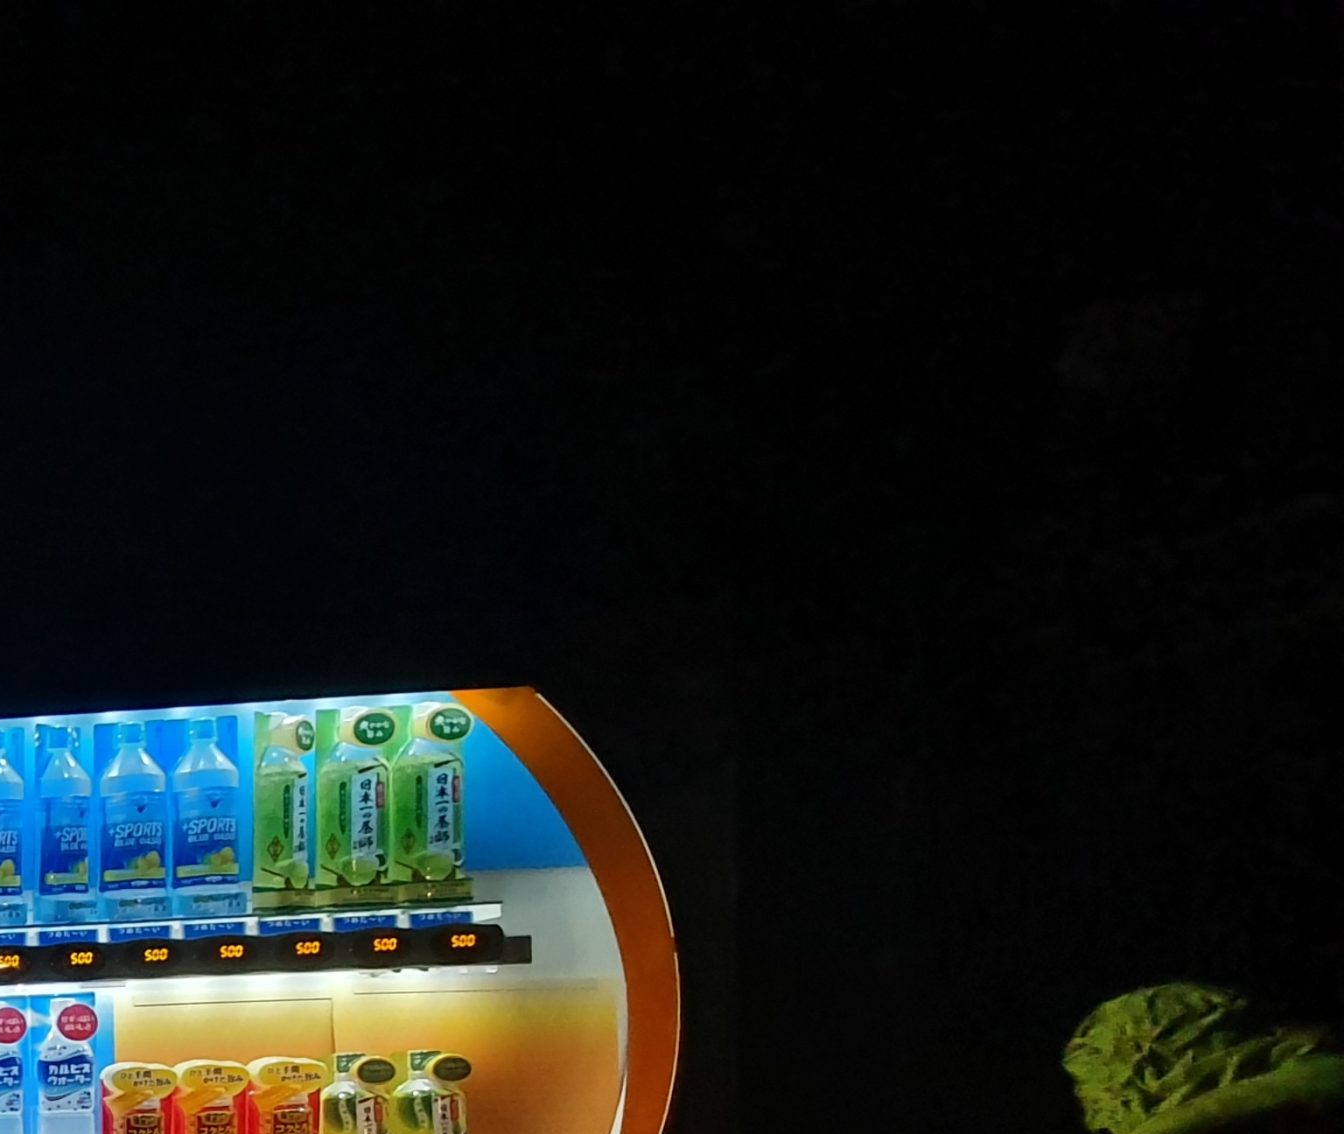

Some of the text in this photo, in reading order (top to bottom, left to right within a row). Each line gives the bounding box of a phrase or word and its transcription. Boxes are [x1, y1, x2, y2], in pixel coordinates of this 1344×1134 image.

[373, 937, 398, 951] 500
[451, 934, 476, 947] 500
[220, 945, 243, 958] 500
[295, 941, 320, 954] 500
[70, 952, 93, 964] 500
[144, 948, 168, 961] 500
[48, 1064, 91, 1075] カルピス
